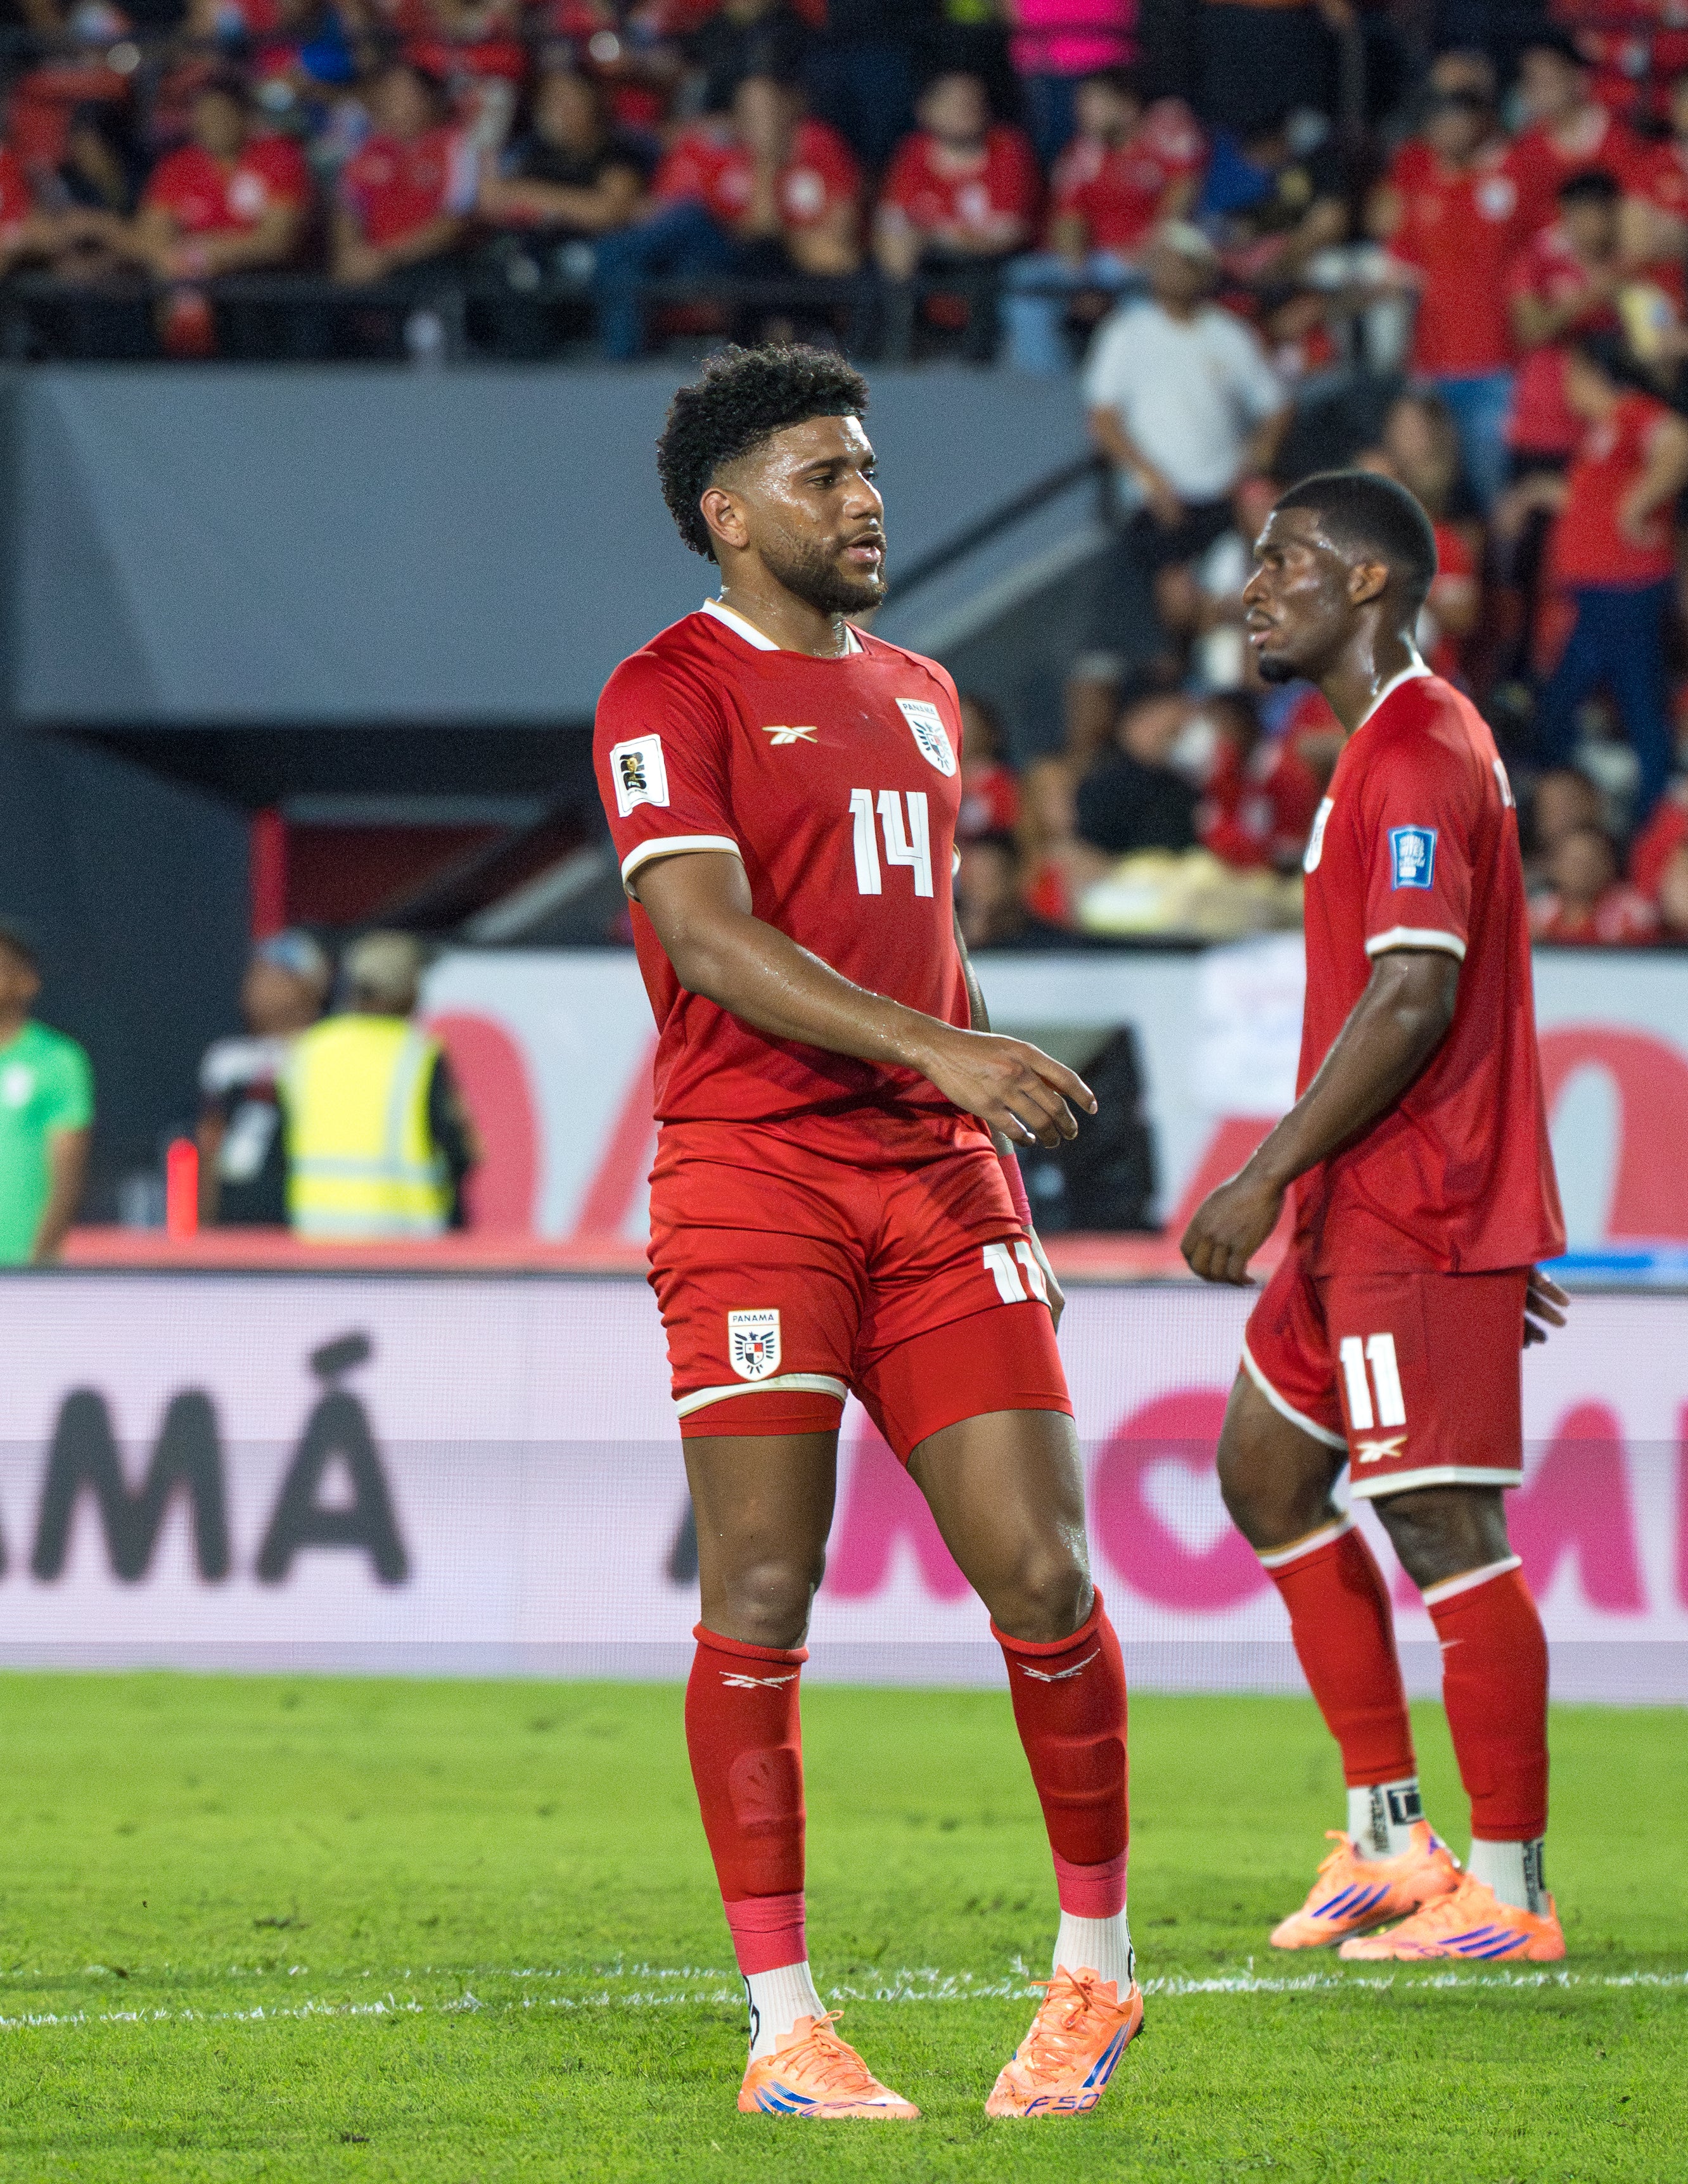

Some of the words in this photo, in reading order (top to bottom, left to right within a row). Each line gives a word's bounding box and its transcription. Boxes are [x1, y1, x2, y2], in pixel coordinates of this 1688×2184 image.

[902, 703, 936, 715] PANAMA
[848, 788, 934, 898] 14
[732, 1313, 774, 1323] PANAMA
[1341, 1332, 1406, 1430] 11
[0, 1329, 409, 1589] MÁ
[1024, 2093, 1100, 2116] F50
